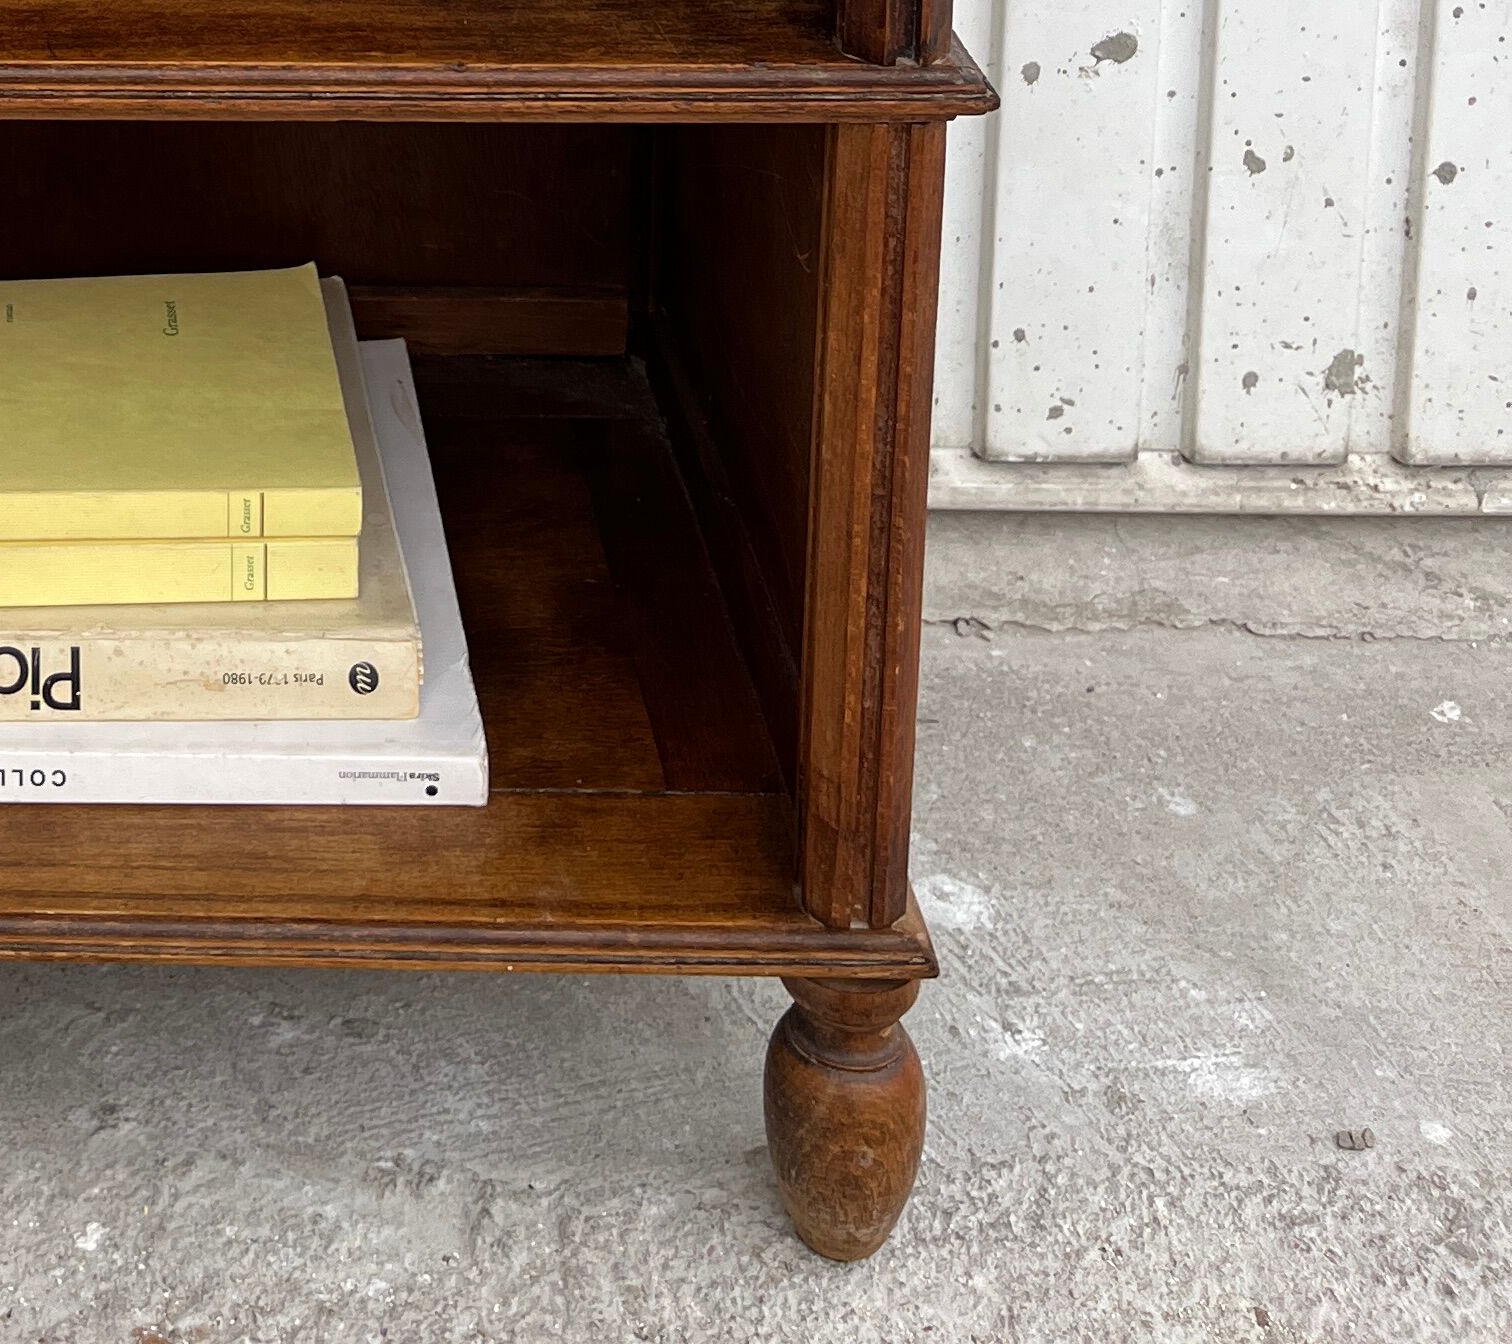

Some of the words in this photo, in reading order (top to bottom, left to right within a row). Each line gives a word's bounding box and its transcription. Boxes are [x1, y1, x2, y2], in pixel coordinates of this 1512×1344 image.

[163, 300, 179, 336] Grasset
[223, 673, 289, 686] 179-1980
[294, 673, 324, 686] Paris
